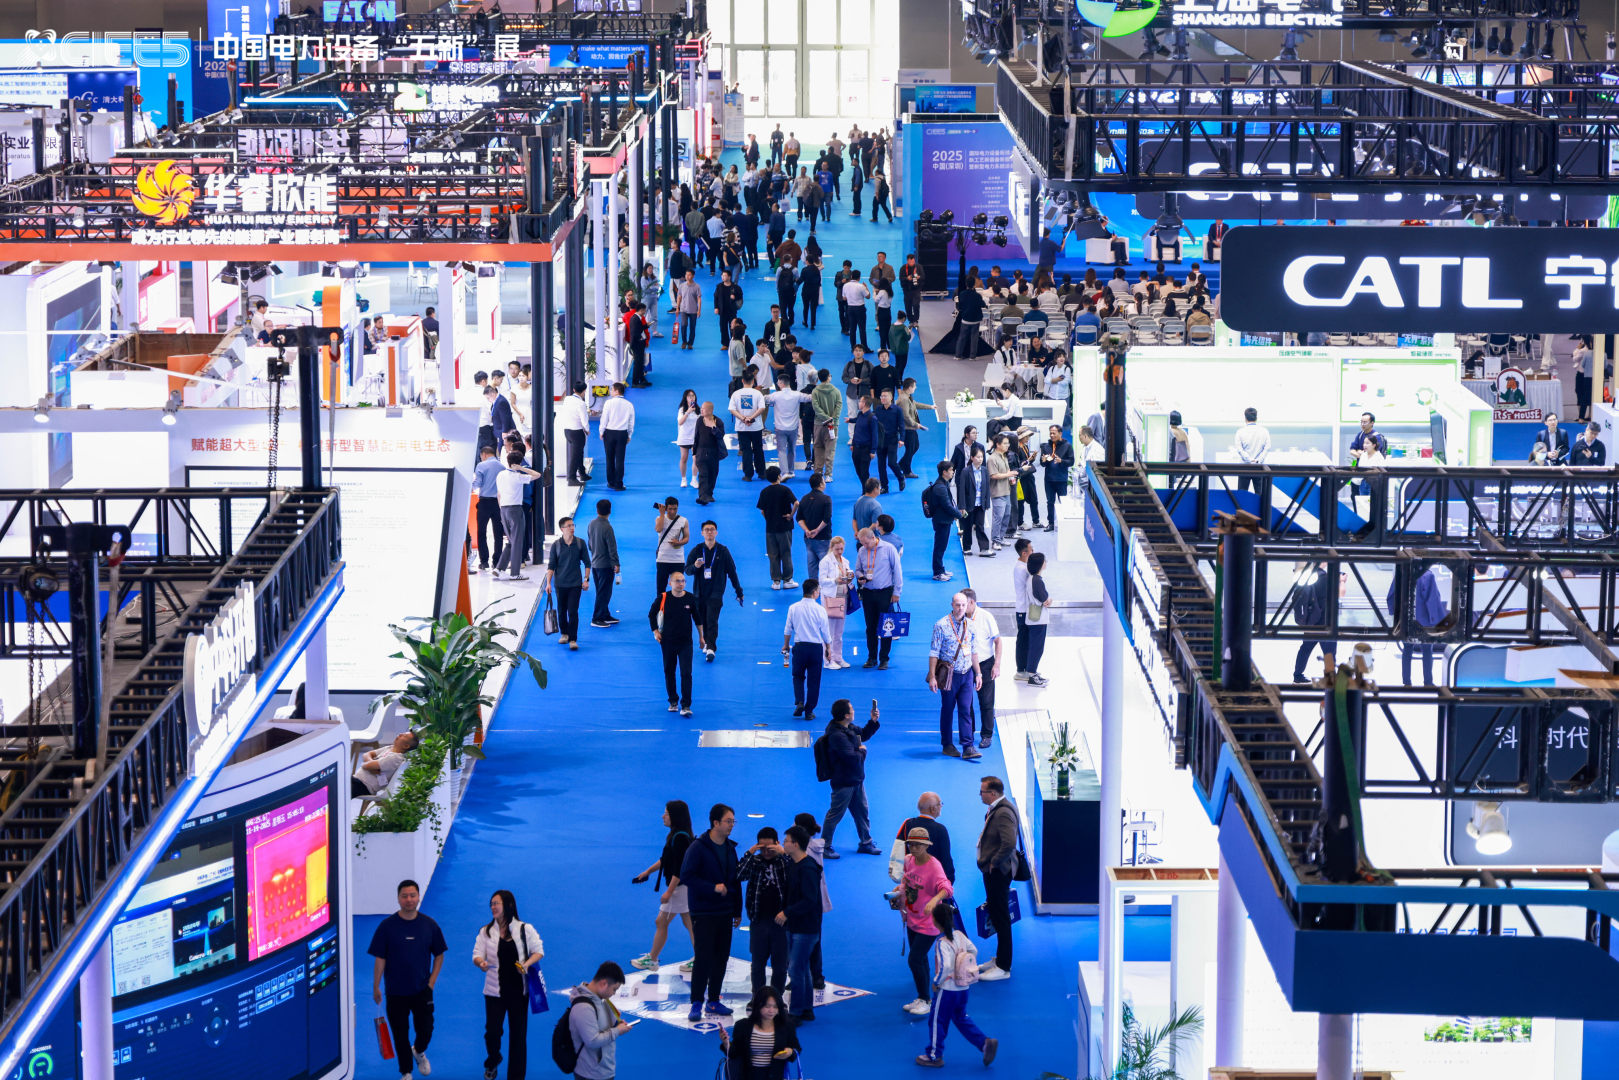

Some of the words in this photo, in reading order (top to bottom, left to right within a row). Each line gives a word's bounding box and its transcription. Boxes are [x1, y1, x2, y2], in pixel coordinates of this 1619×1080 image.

[323, 1, 396, 22] EATON
[1172, 13, 1261, 26] SHANGHAI
[1265, 13, 1343, 27] ELECTRIC
[932, 150, 963, 162] 2025
[932, 162, 964, 171] 中国(深圳)
[203, 173, 337, 212] 华睿欣能
[204, 215, 231, 225] HUA
[233, 215, 255, 225] RUI
[256, 215, 285, 225] NEW
[286, 215, 338, 225] ENERGY
[1283, 256, 1523, 308] CATL
[1545, 255, 1619, 309] 宁
